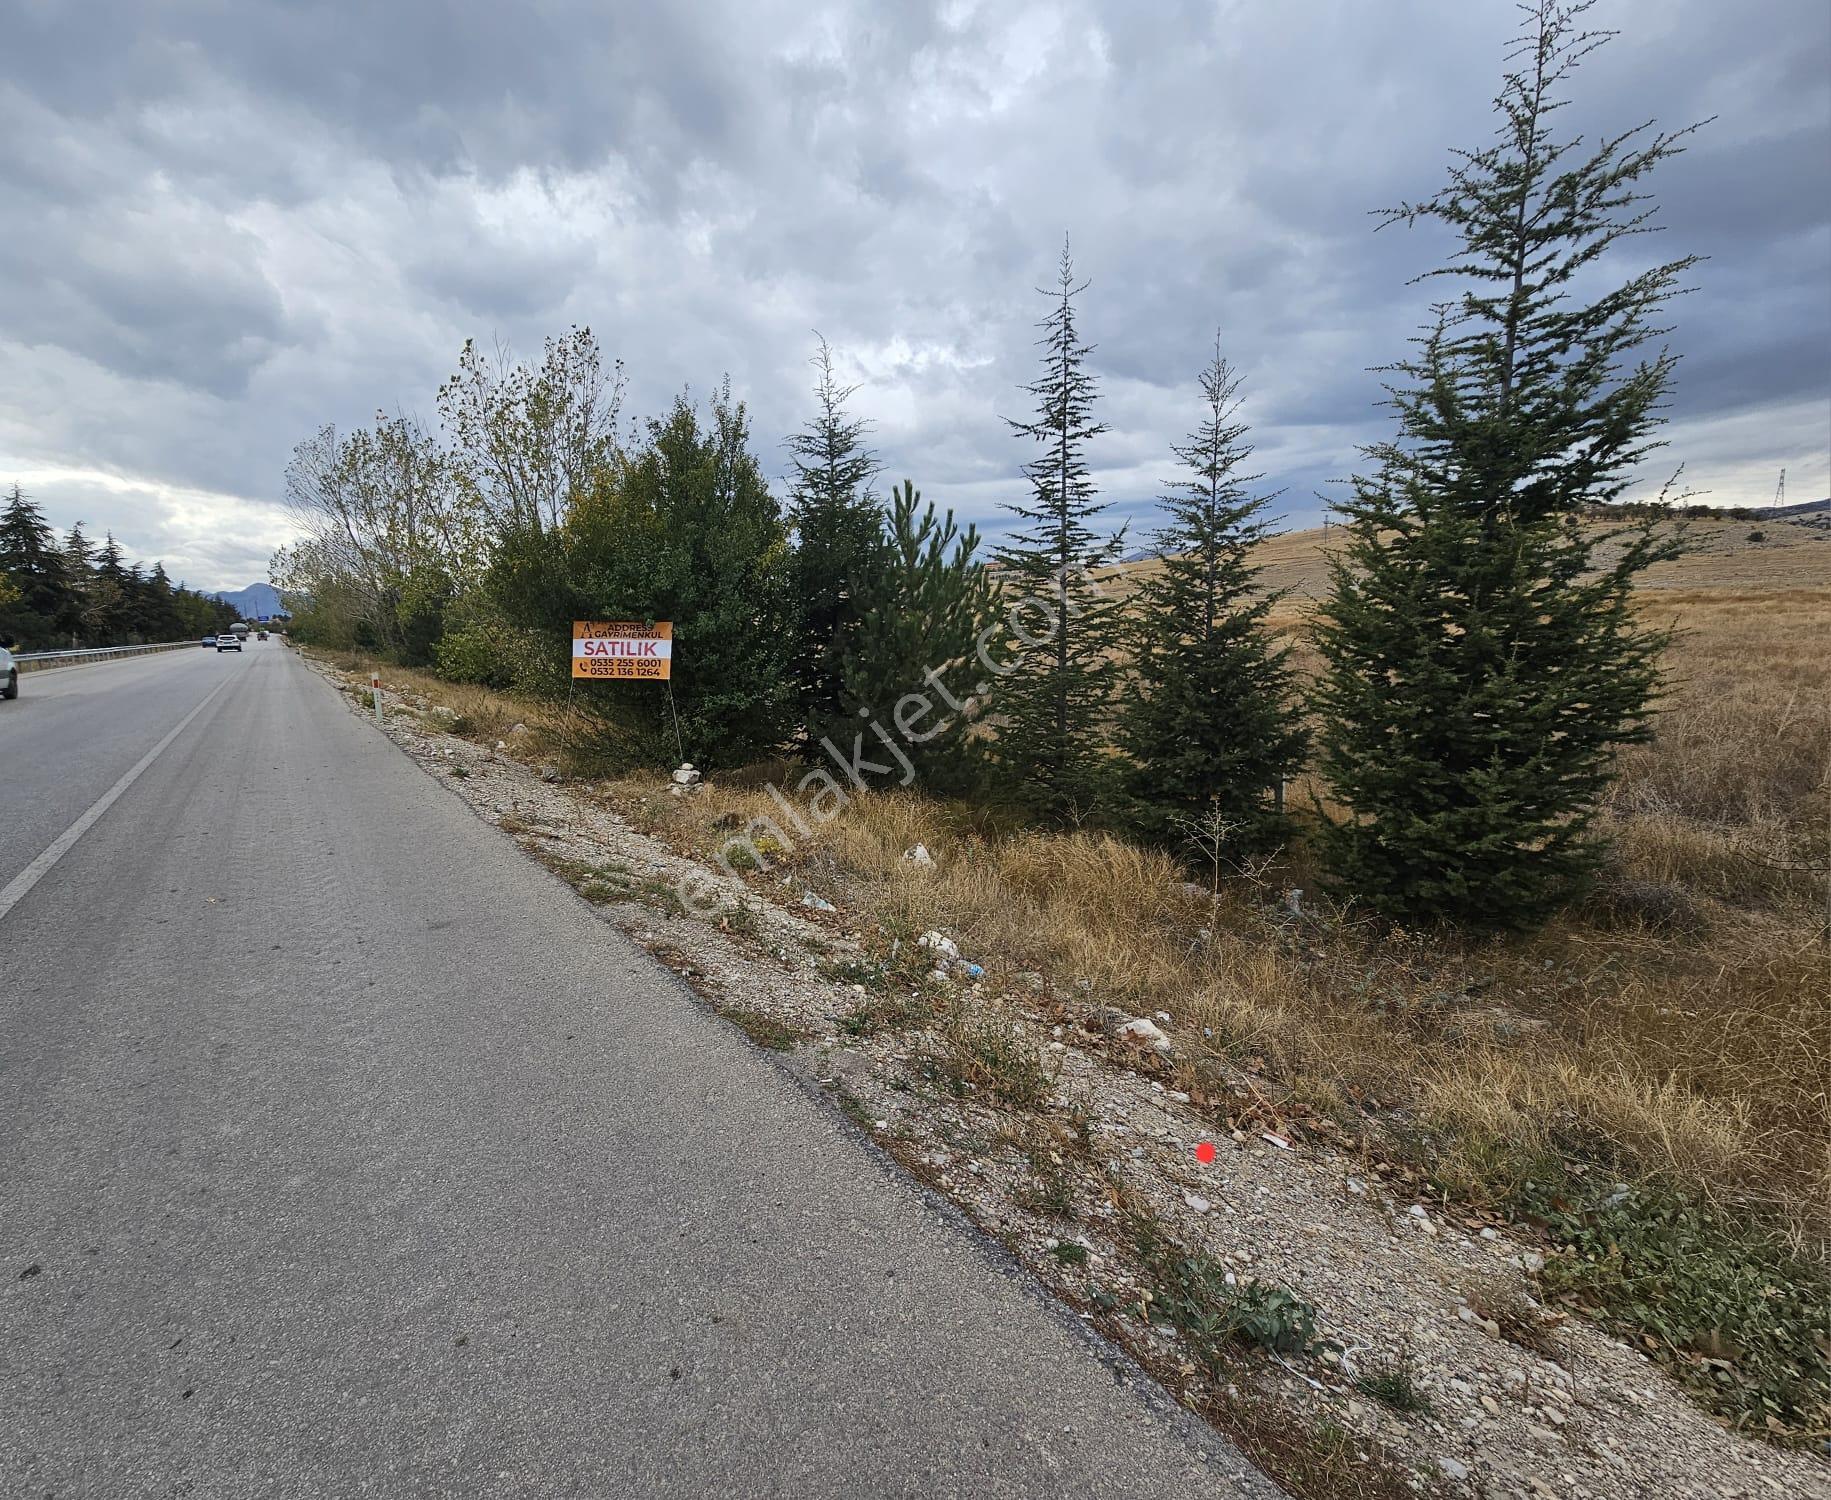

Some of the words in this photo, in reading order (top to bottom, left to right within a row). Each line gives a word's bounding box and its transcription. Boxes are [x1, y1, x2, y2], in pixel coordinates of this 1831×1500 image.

[584, 641, 658, 656] SATILIK
[590, 659, 614, 667] 0535
[616, 659, 634, 667] 255
[637, 659, 661, 667] 6001
[590, 667, 615, 675] 0532
[618, 668, 634, 676] 136
[636, 668, 660, 676] 1264
